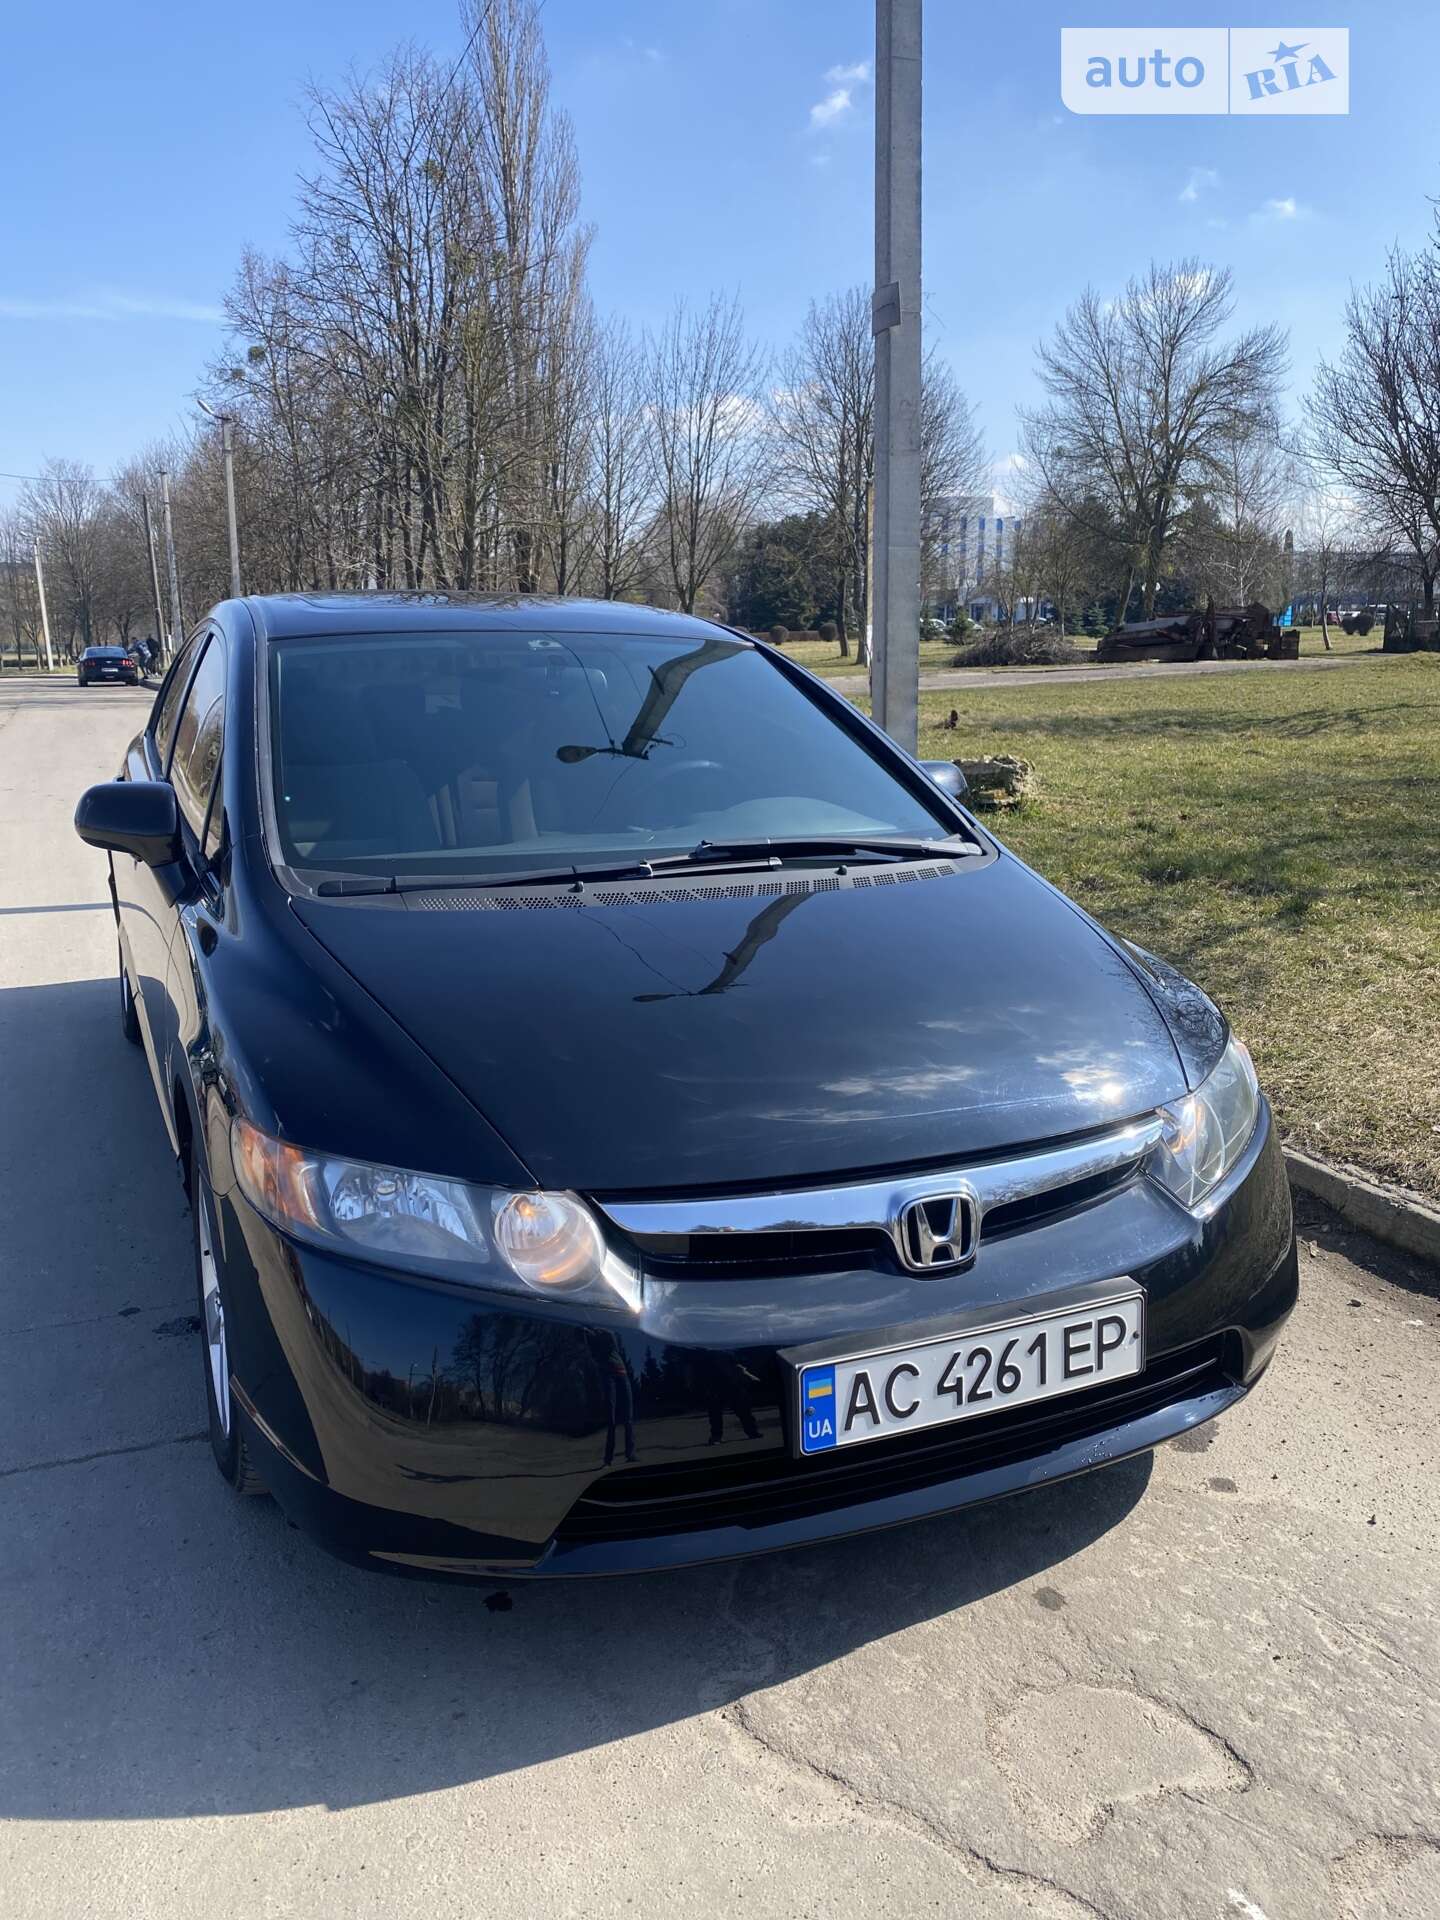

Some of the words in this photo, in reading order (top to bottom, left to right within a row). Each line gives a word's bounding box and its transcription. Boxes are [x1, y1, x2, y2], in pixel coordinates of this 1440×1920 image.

[844, 1363, 921, 1431] AC
[936, 1332, 1047, 1405] 4261
[1062, 1314, 1127, 1379] EP
[808, 1418, 833, 1439] UA
